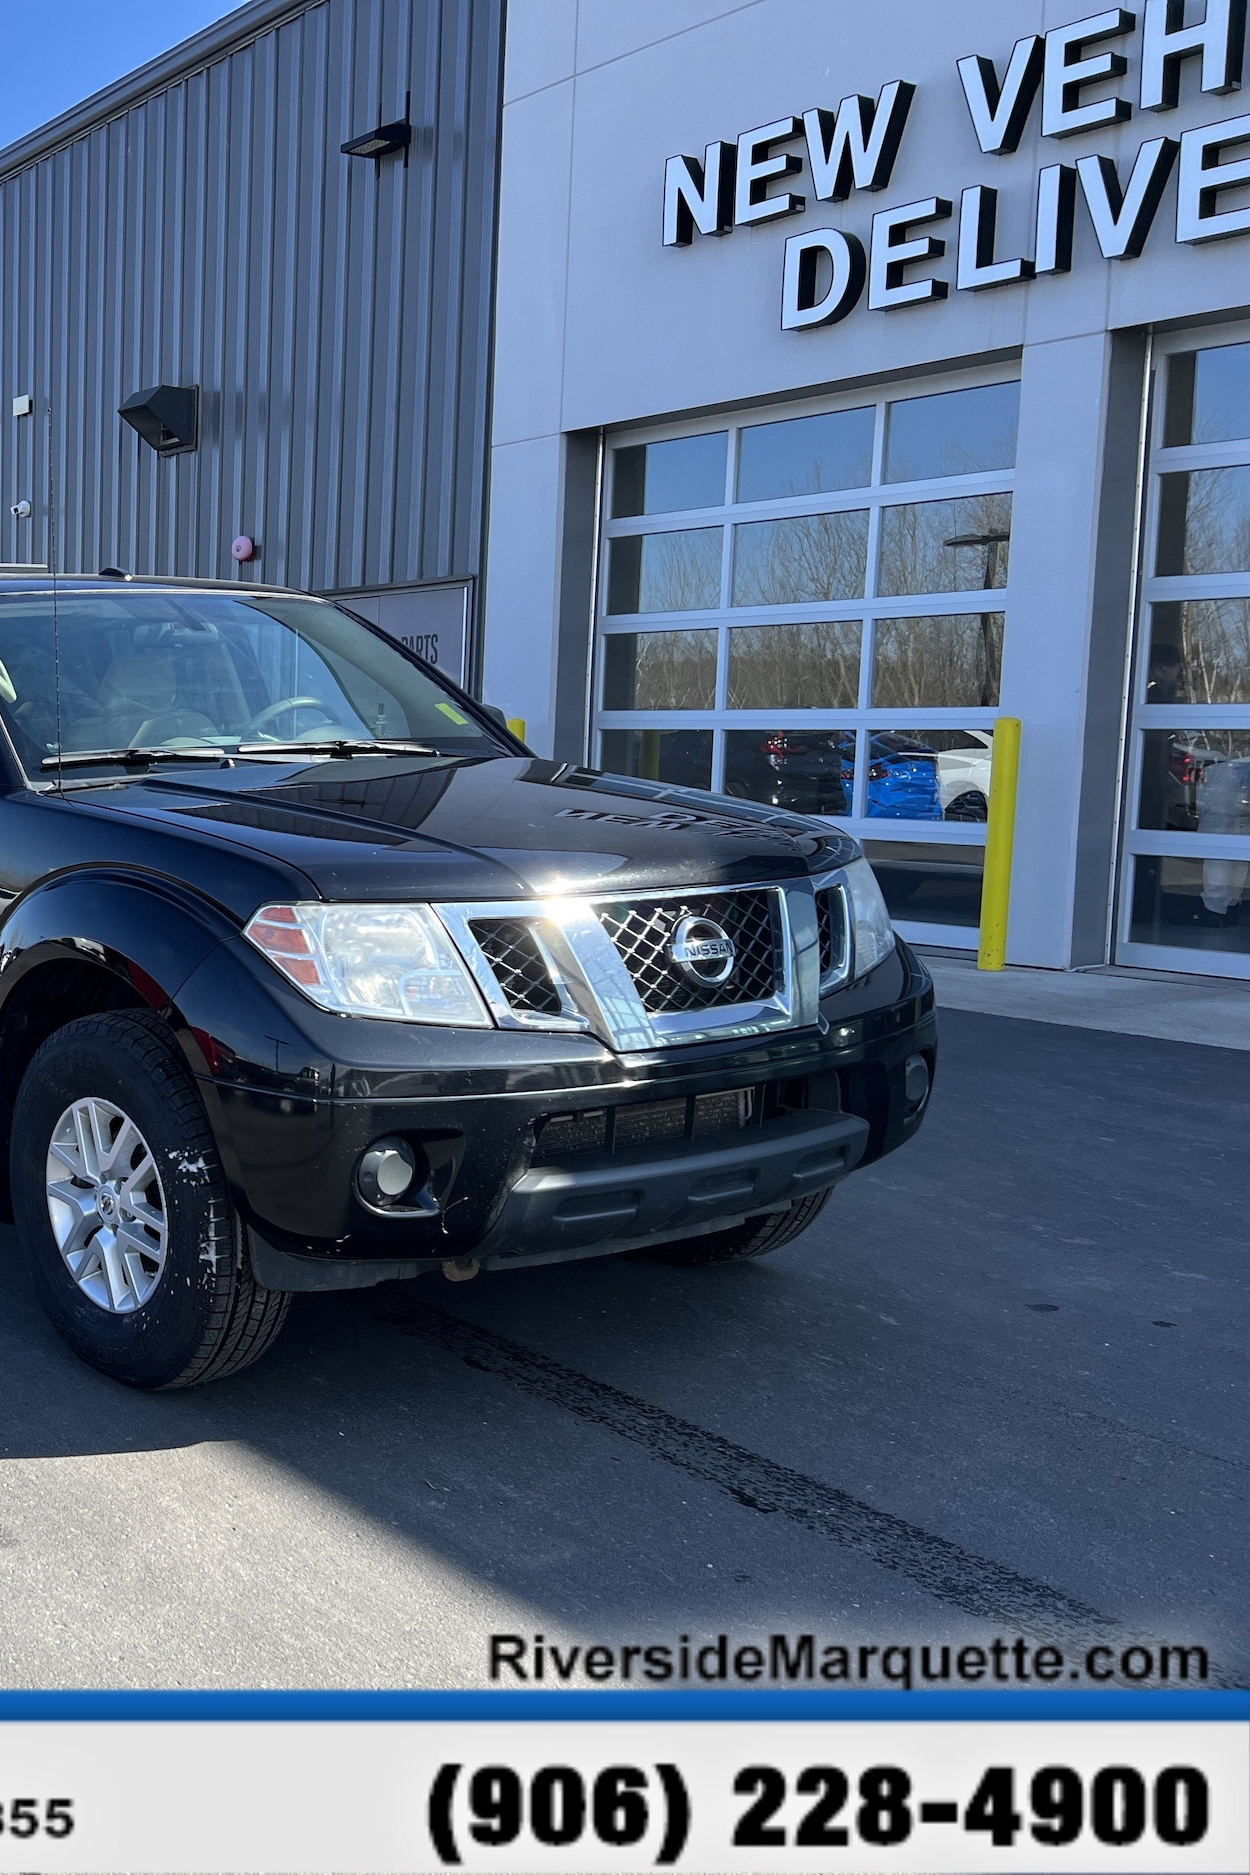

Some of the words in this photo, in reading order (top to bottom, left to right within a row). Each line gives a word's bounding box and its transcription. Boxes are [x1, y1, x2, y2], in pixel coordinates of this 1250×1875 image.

[662, 79, 916, 248] NEW
[956, 0, 1247, 155] VEH
[781, 113, 1250, 332] DELIVE
[685, 943, 735, 958] NISSAN
